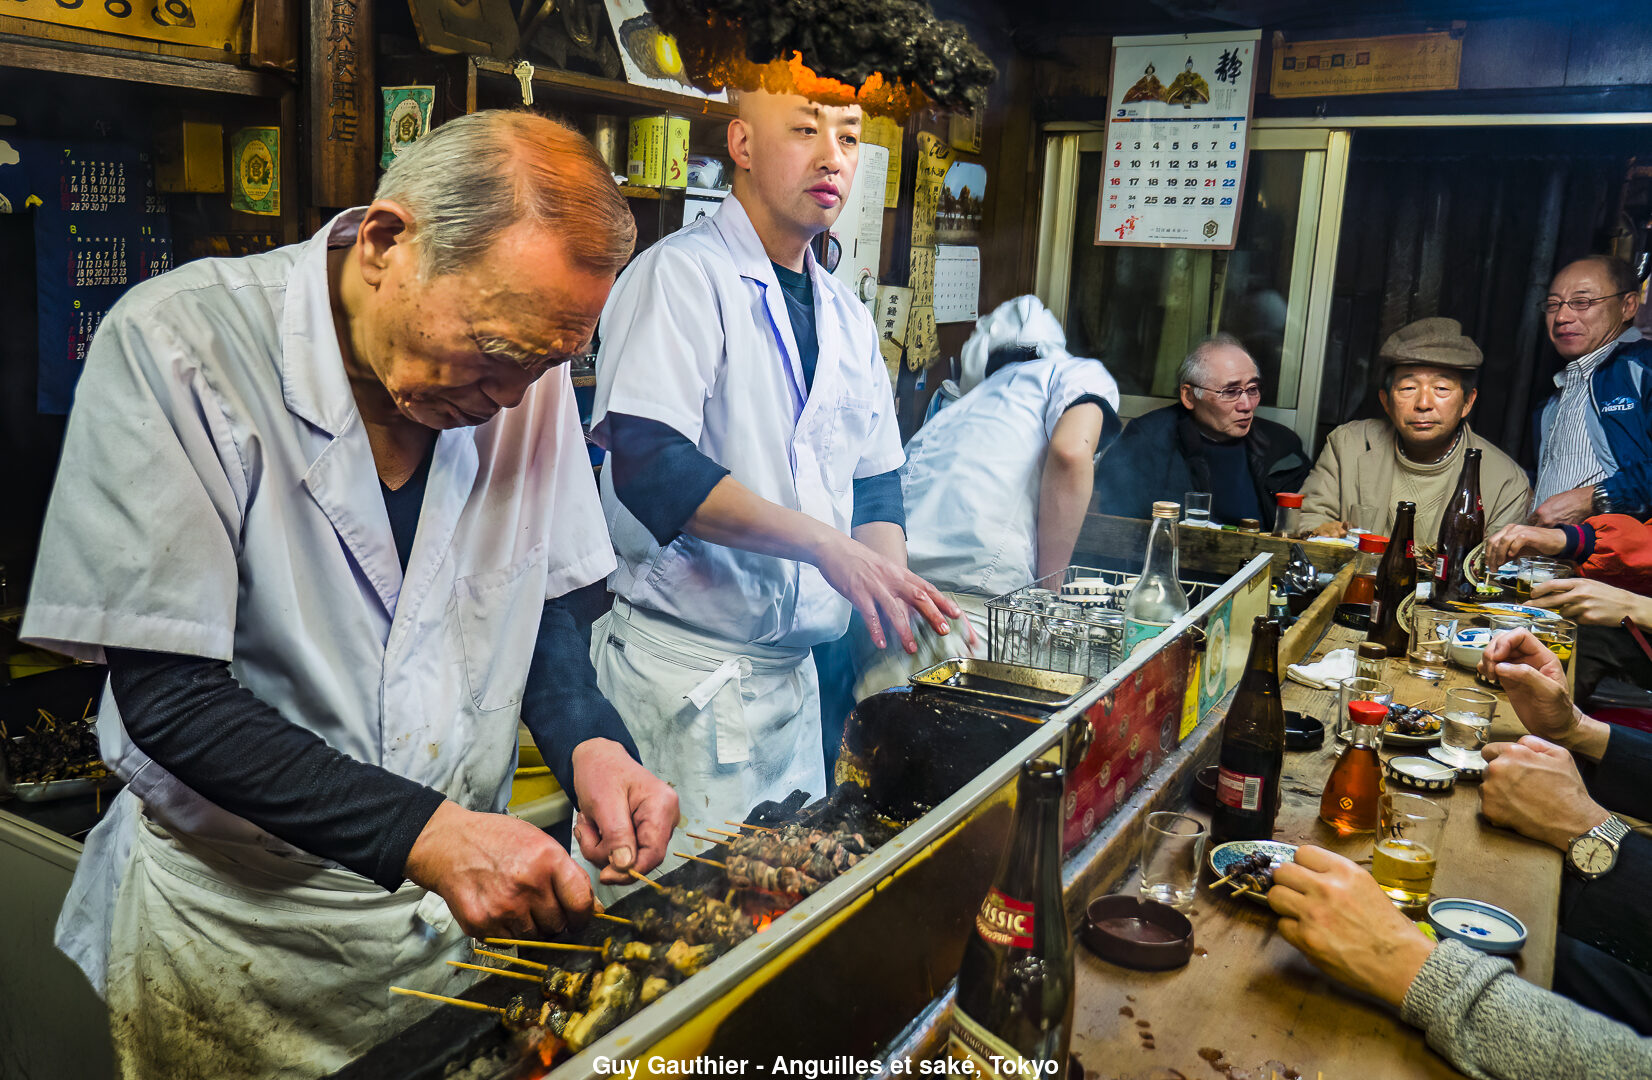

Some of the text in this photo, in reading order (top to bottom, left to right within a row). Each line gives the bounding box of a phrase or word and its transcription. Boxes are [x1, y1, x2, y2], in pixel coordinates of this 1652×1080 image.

[1117, 109, 1126, 117] 3
[1115, 141, 1236, 150] 2 3 4 5 6 7 8
[64, 149, 71, 157] 7
[1113, 160, 1120, 168] 9
[1130, 160, 1141, 168] 10
[1168, 160, 1179, 168] 12
[1187, 160, 1198, 168] 13
[1206, 160, 1217, 168] 14
[1226, 160, 1237, 168] 15
[71, 176, 76, 184] 7
[81, 176, 86, 184] 8
[91, 176, 96, 184] 9
[100, 177, 107, 185] 10
[109, 177, 115, 185] 11
[1110, 178, 1120, 186] 16
[1129, 178, 1140, 186] 17
[1147, 178, 1158, 186] 18
[1184, 179, 1197, 187] 20
[1204, 179, 1216, 187] 21
[1222, 179, 1235, 187] 22
[71, 185, 78, 193] 14
[81, 185, 88, 193] 15
[91, 185, 98, 193] 16
[109, 186, 116, 194] 18
[118, 186, 125, 194] 19
[81, 194, 126, 203] 22 23 24 25 26
[1144, 196, 1158, 204] 25
[1164, 196, 1177, 204] 26
[1182, 197, 1196, 205] 27
[1201, 197, 1214, 205] 28
[1220, 197, 1233, 205] 29
[71, 203, 80, 211] 28
[81, 203, 89, 211] 29
[91, 203, 99, 211] 30
[70, 225, 77, 234] 8
[142, 226, 151, 235] 11
[78, 251, 125, 260] 4 5 6 7 8 9
[161, 252, 167, 260] 4
[95, 260, 102, 268] 13
[103, 260, 110, 268] 14
[161, 261, 168, 269] 11
[76, 268, 126, 277] 18 19 20 21 22 23
[76, 277, 127, 286] 25 26 27 28 29 30
[74, 300, 81, 309] 9
[960, 1029, 997, 1062] COMPAN
